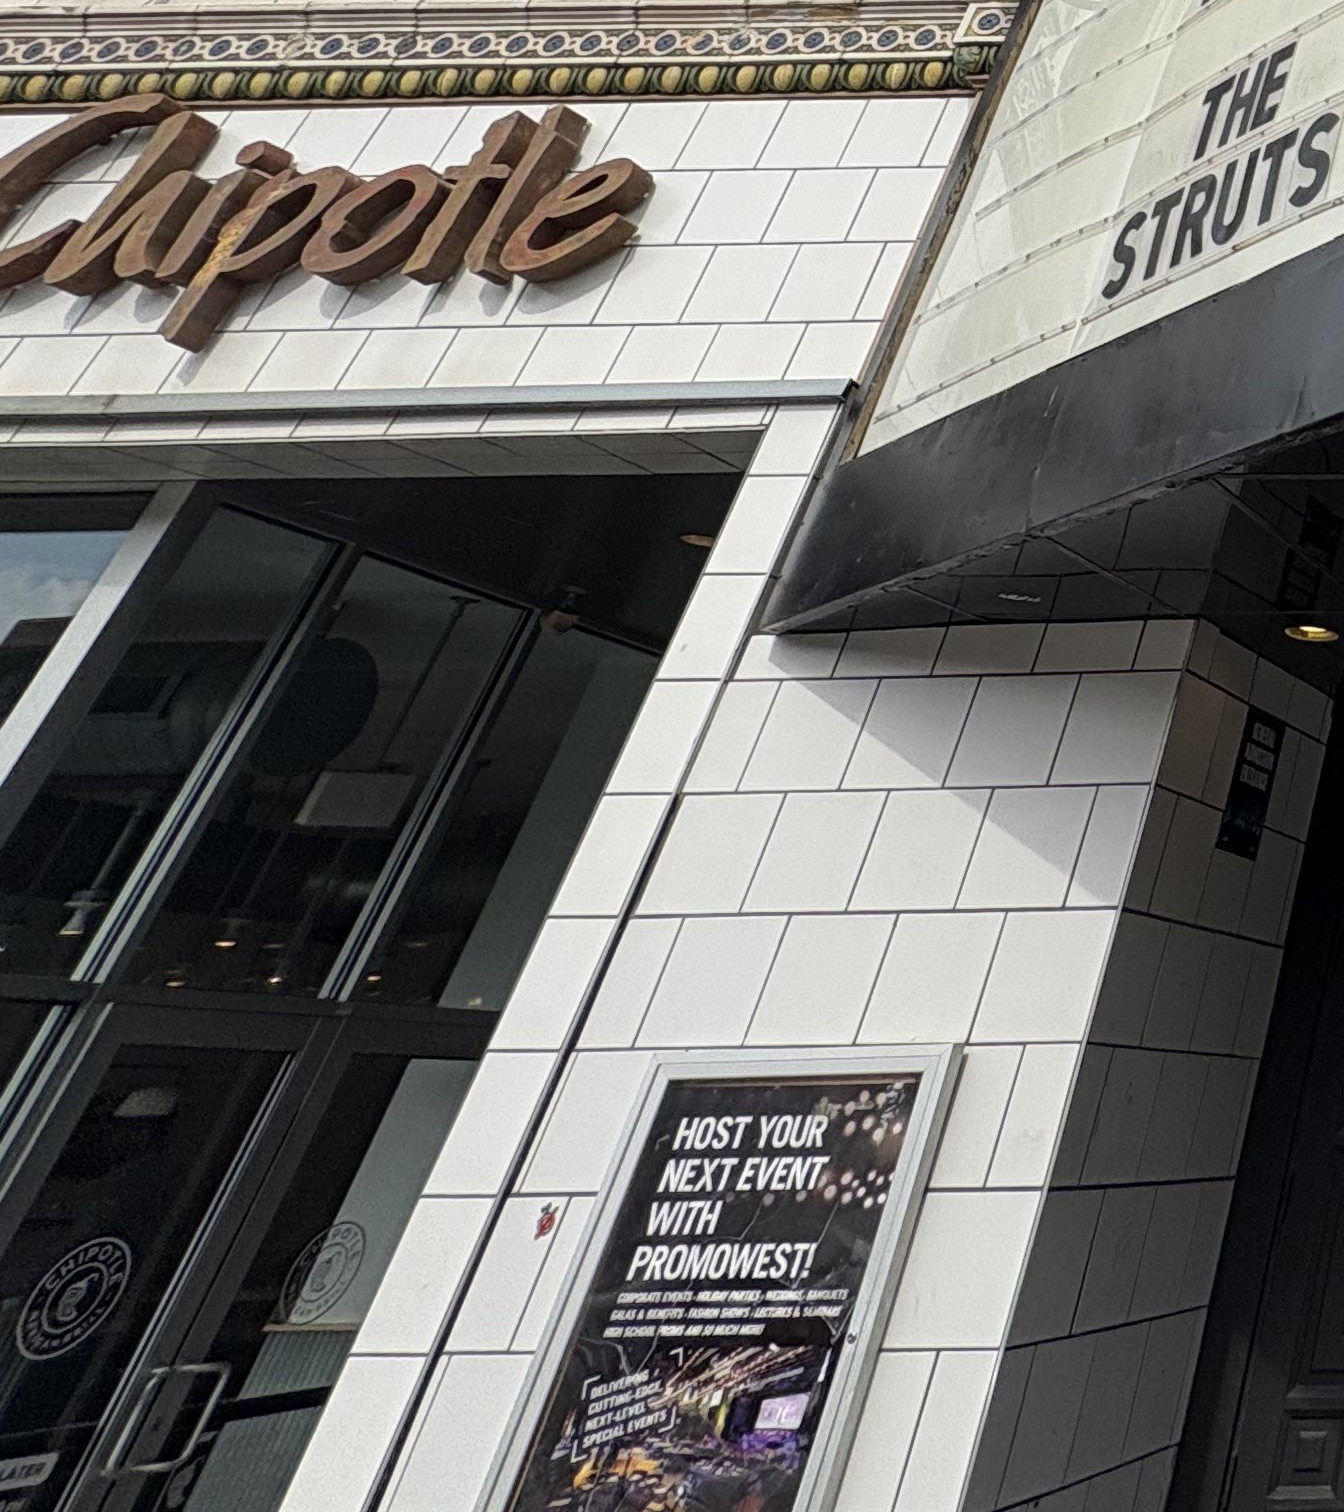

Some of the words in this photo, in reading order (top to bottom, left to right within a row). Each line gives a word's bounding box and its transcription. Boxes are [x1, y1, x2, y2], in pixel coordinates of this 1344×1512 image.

[1193, 40, 1298, 163] THE
[0, 92, 655, 354] Chipotle
[1101, 111, 1341, 300] STRUTS
[672, 1115, 753, 1151] HOST
[758, 1113, 830, 1149] YOUR
[656, 1157, 740, 1193] NEXT
[737, 1155, 831, 1192] EVENT
[645, 1200, 724, 1236] WITH
[45, 1244, 124, 1291] CHIPOTLE
[625, 1241, 820, 1281] PROMOWEST!
[582, 1423, 625, 1449] SPECIAL
[626, 1409, 668, 1434] EVENTS
